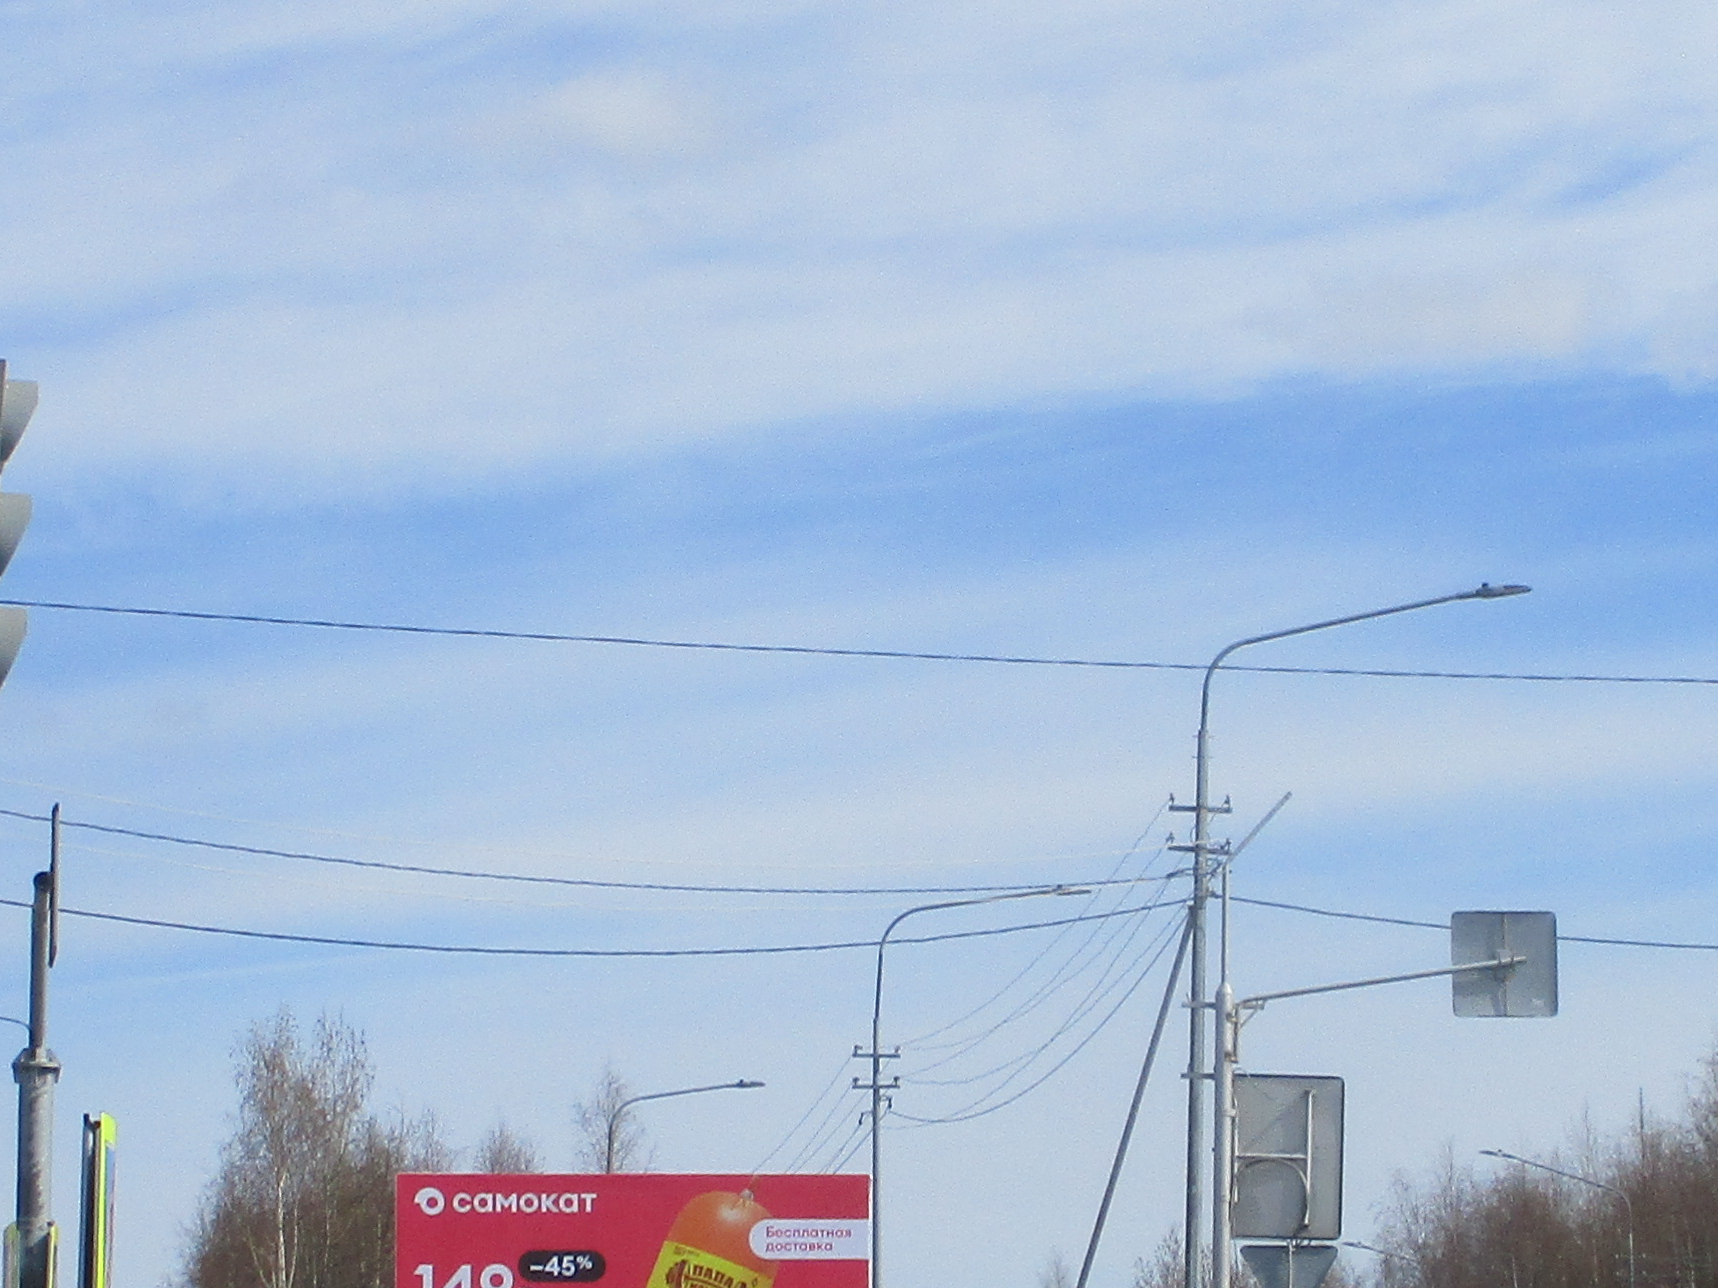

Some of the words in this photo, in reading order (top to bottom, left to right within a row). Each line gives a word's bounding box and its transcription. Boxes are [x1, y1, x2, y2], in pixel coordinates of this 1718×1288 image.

[452, 1192, 597, 1213] самокат
[766, 1225, 852, 1238] Бесплатная
[765, 1242, 833, 1253] доставка
